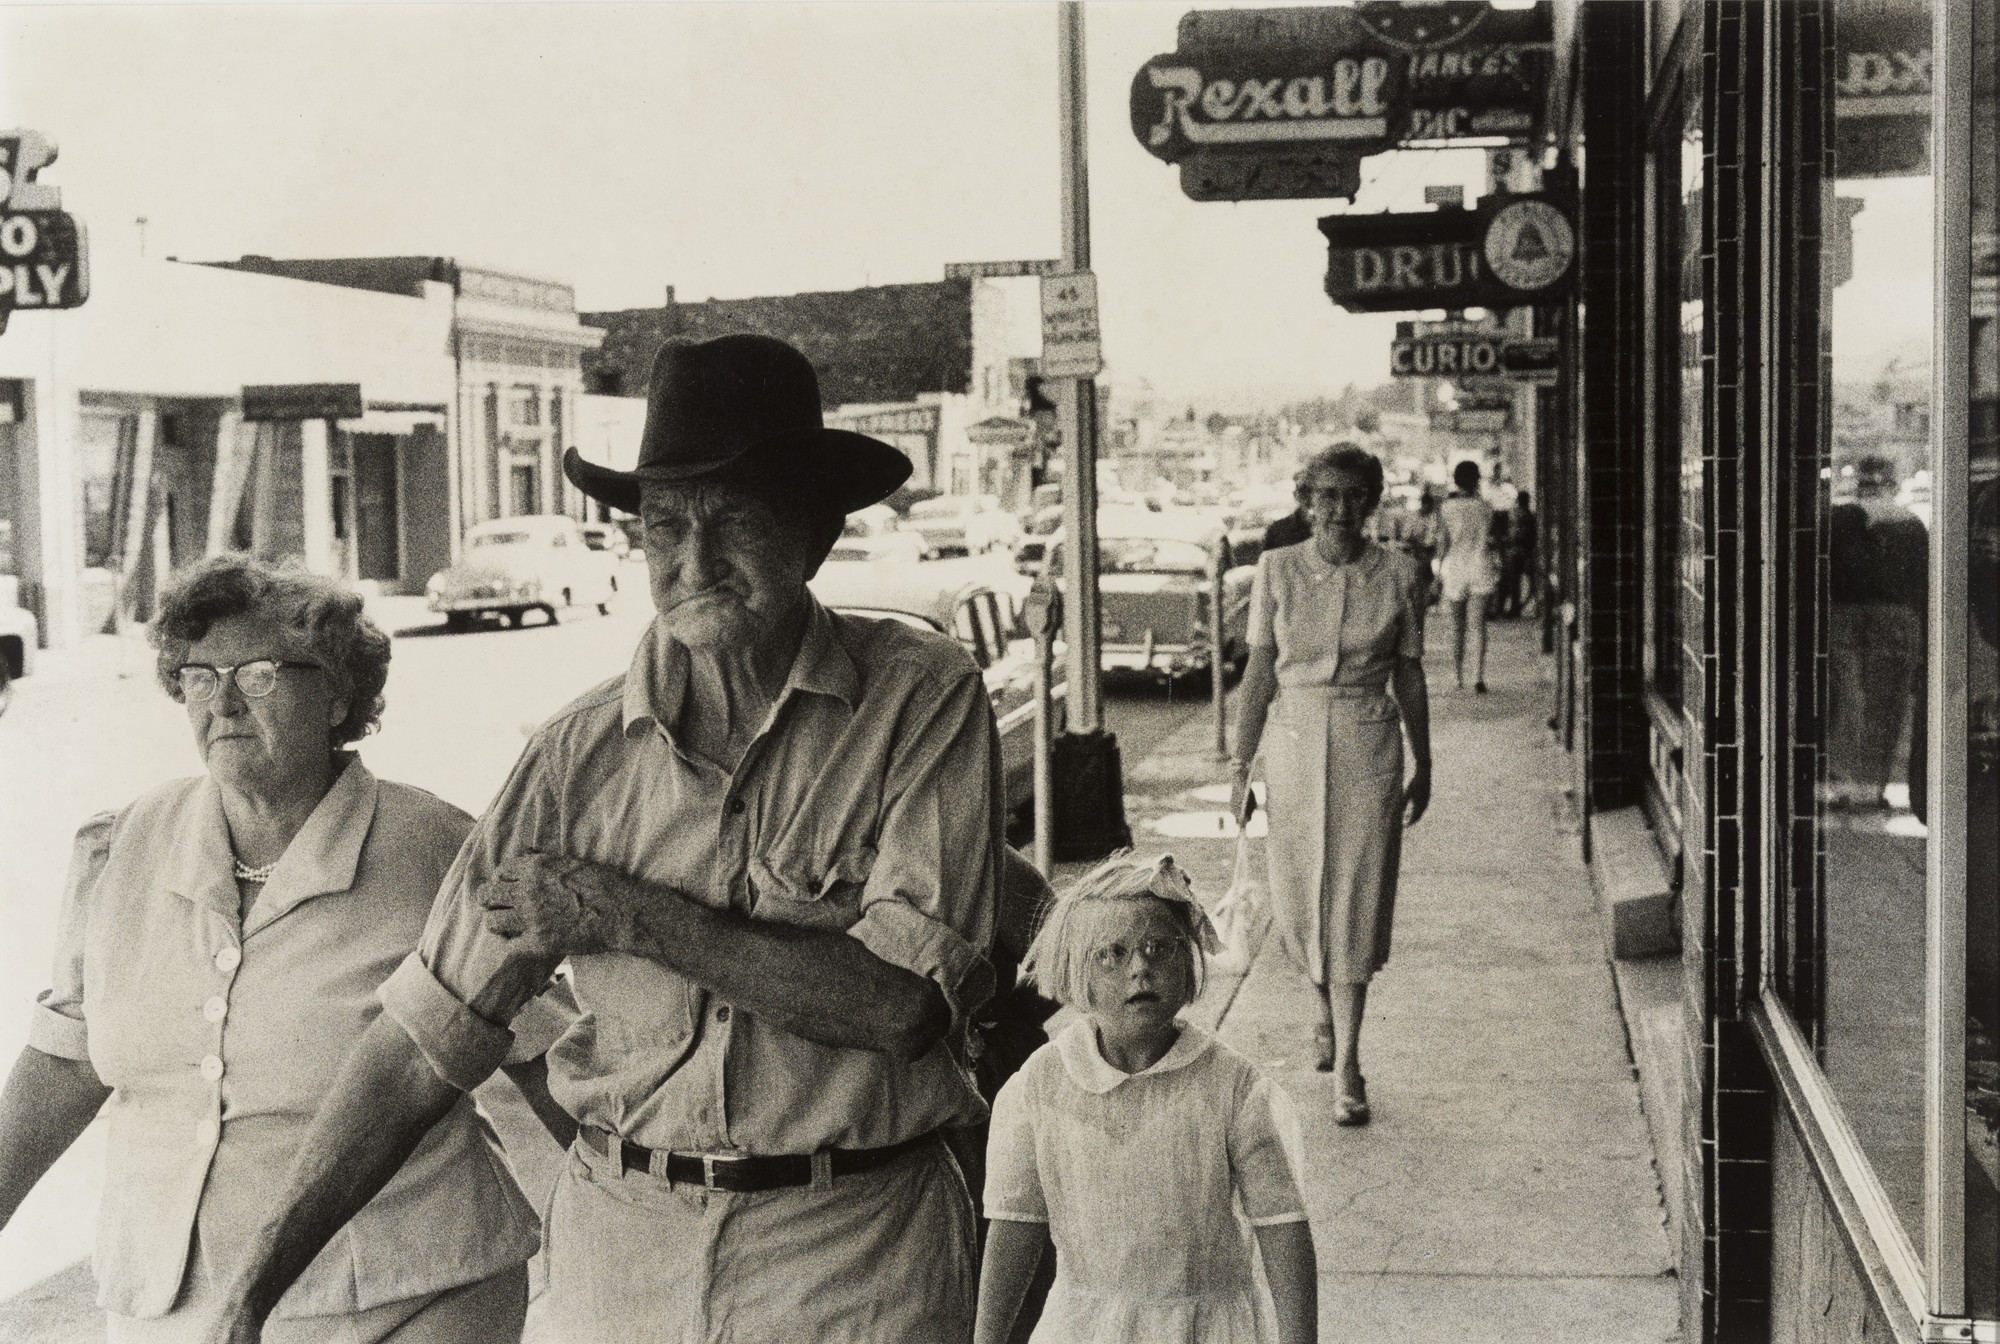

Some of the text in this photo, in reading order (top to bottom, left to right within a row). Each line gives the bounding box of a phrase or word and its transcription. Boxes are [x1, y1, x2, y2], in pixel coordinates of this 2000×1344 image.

[1147, 57, 1389, 146] Rexall
[0, 214, 39, 257] O
[1354, 244, 1478, 290] DRU
